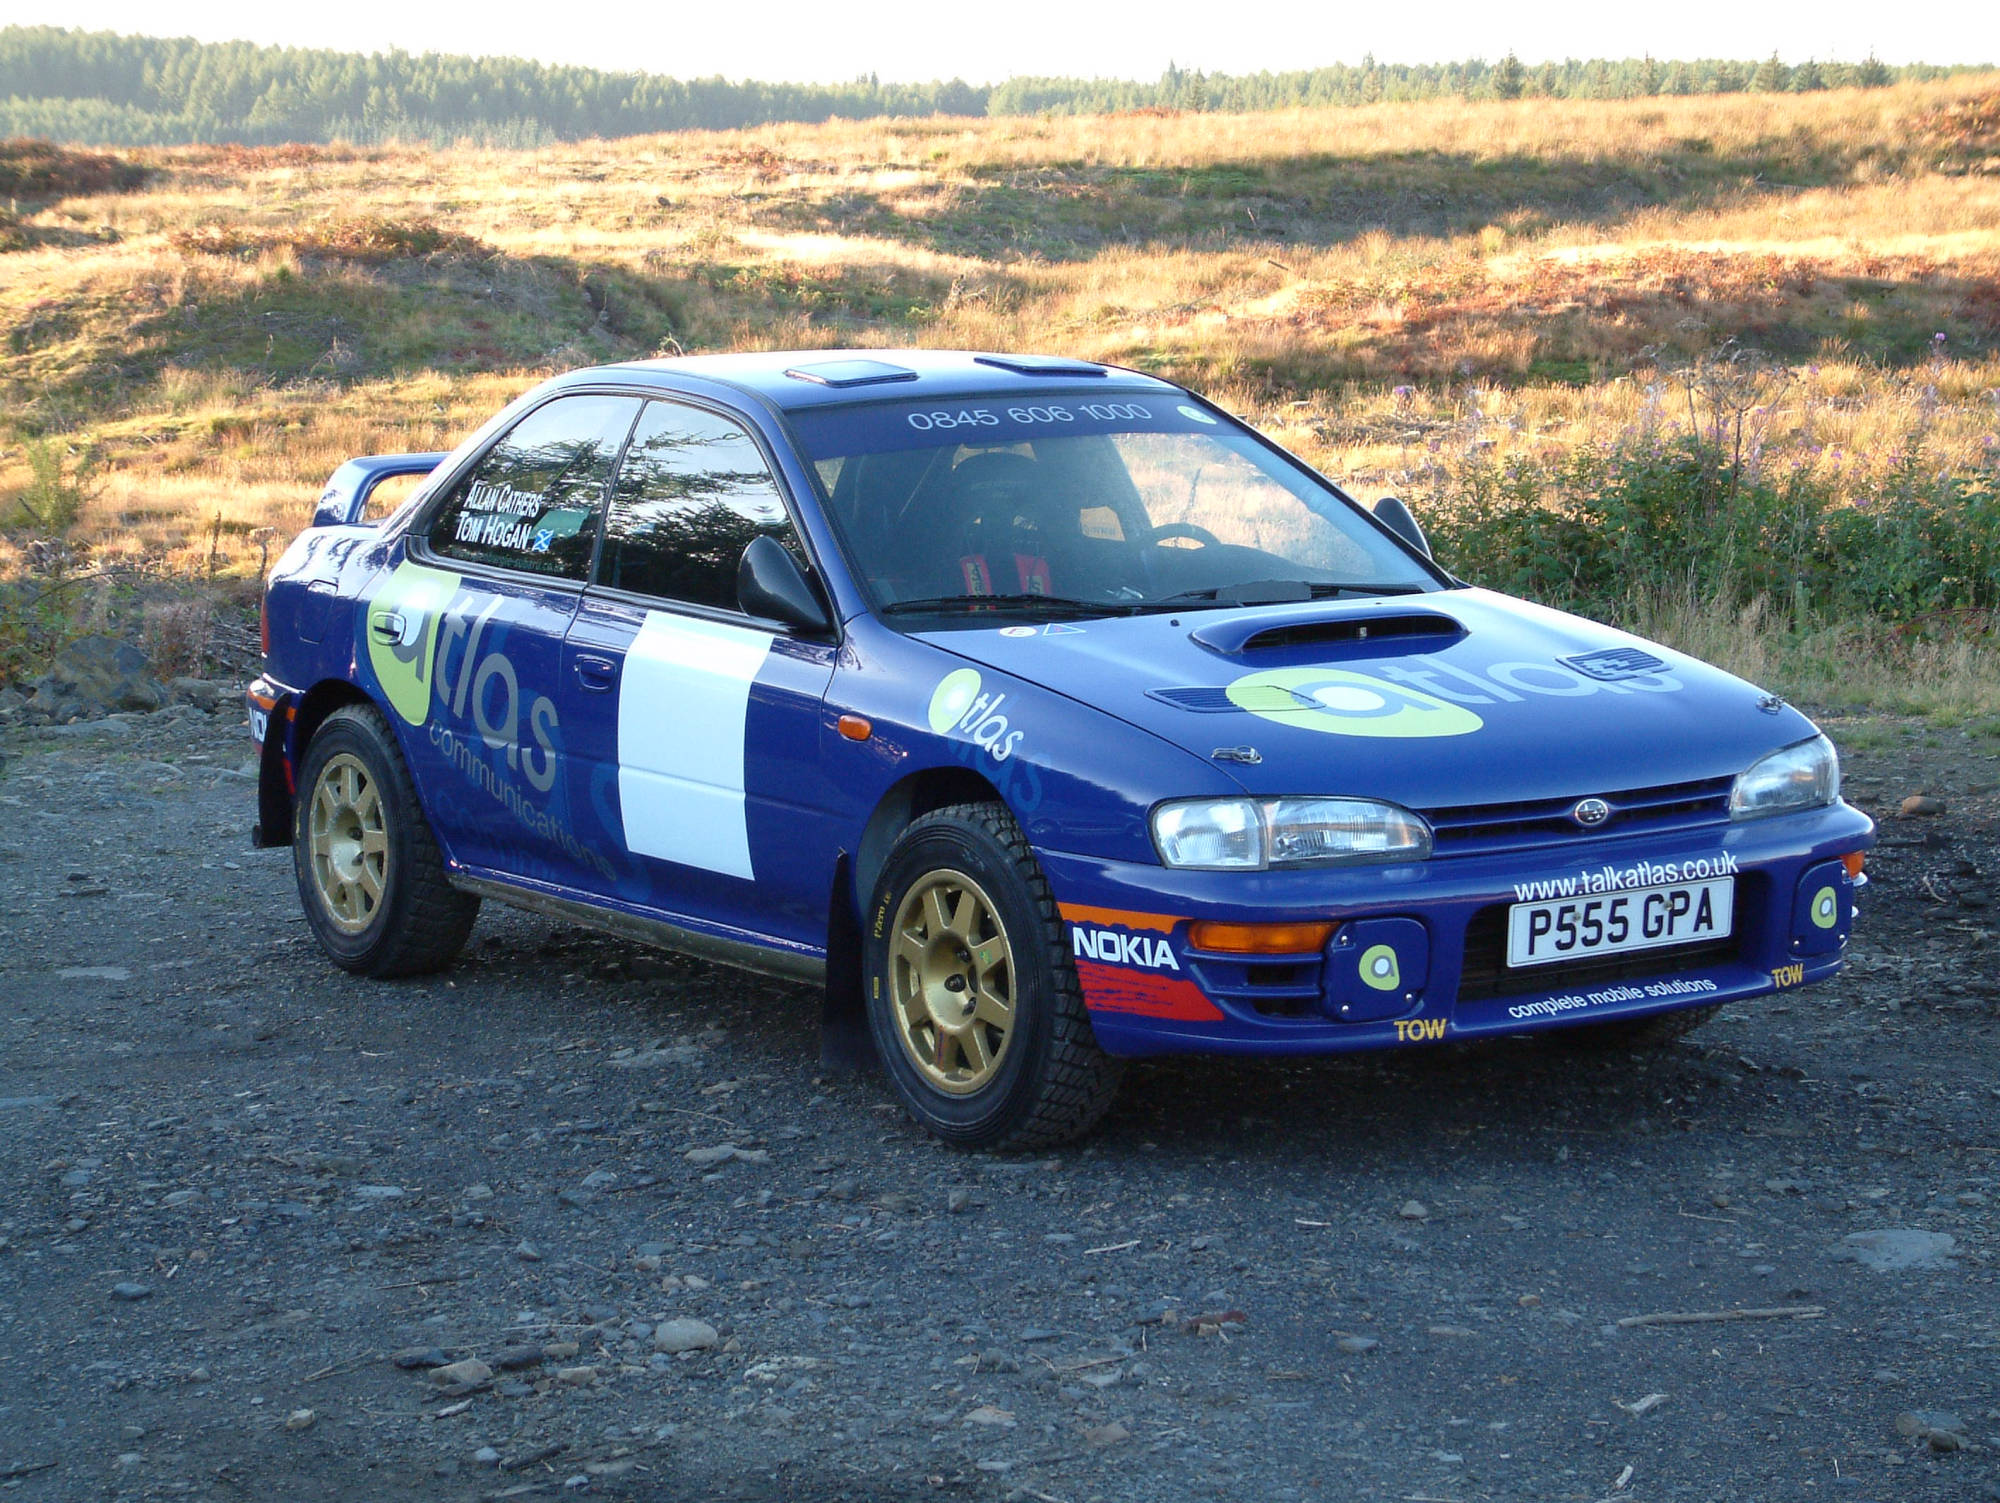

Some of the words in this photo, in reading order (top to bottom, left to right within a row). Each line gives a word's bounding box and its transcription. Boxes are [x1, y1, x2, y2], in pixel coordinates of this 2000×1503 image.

[907, 409, 1000, 430] 0845
[1007, 405, 1074, 424] 606
[1078, 403, 1152, 420] 1000
[463, 480, 500, 512] ALLAN
[497, 484, 543, 518] CATHERS
[455, 511, 483, 542] TOM
[481, 515, 533, 550] HOGAN
[429, 718, 617, 882] communications
[1513, 850, 1739, 901] www.talkatlas.co.uk
[1527, 897, 1630, 956] P555
[1642, 887, 1714, 939] GPA
[1073, 926, 1180, 970] NOKIA
[1771, 963, 1804, 988] TOW
[1508, 992, 1587, 1018] complete
[1588, 984, 1643, 1005] mobile
[1645, 975, 1717, 997] solutions
[1393, 1018, 1447, 1041] TOW
